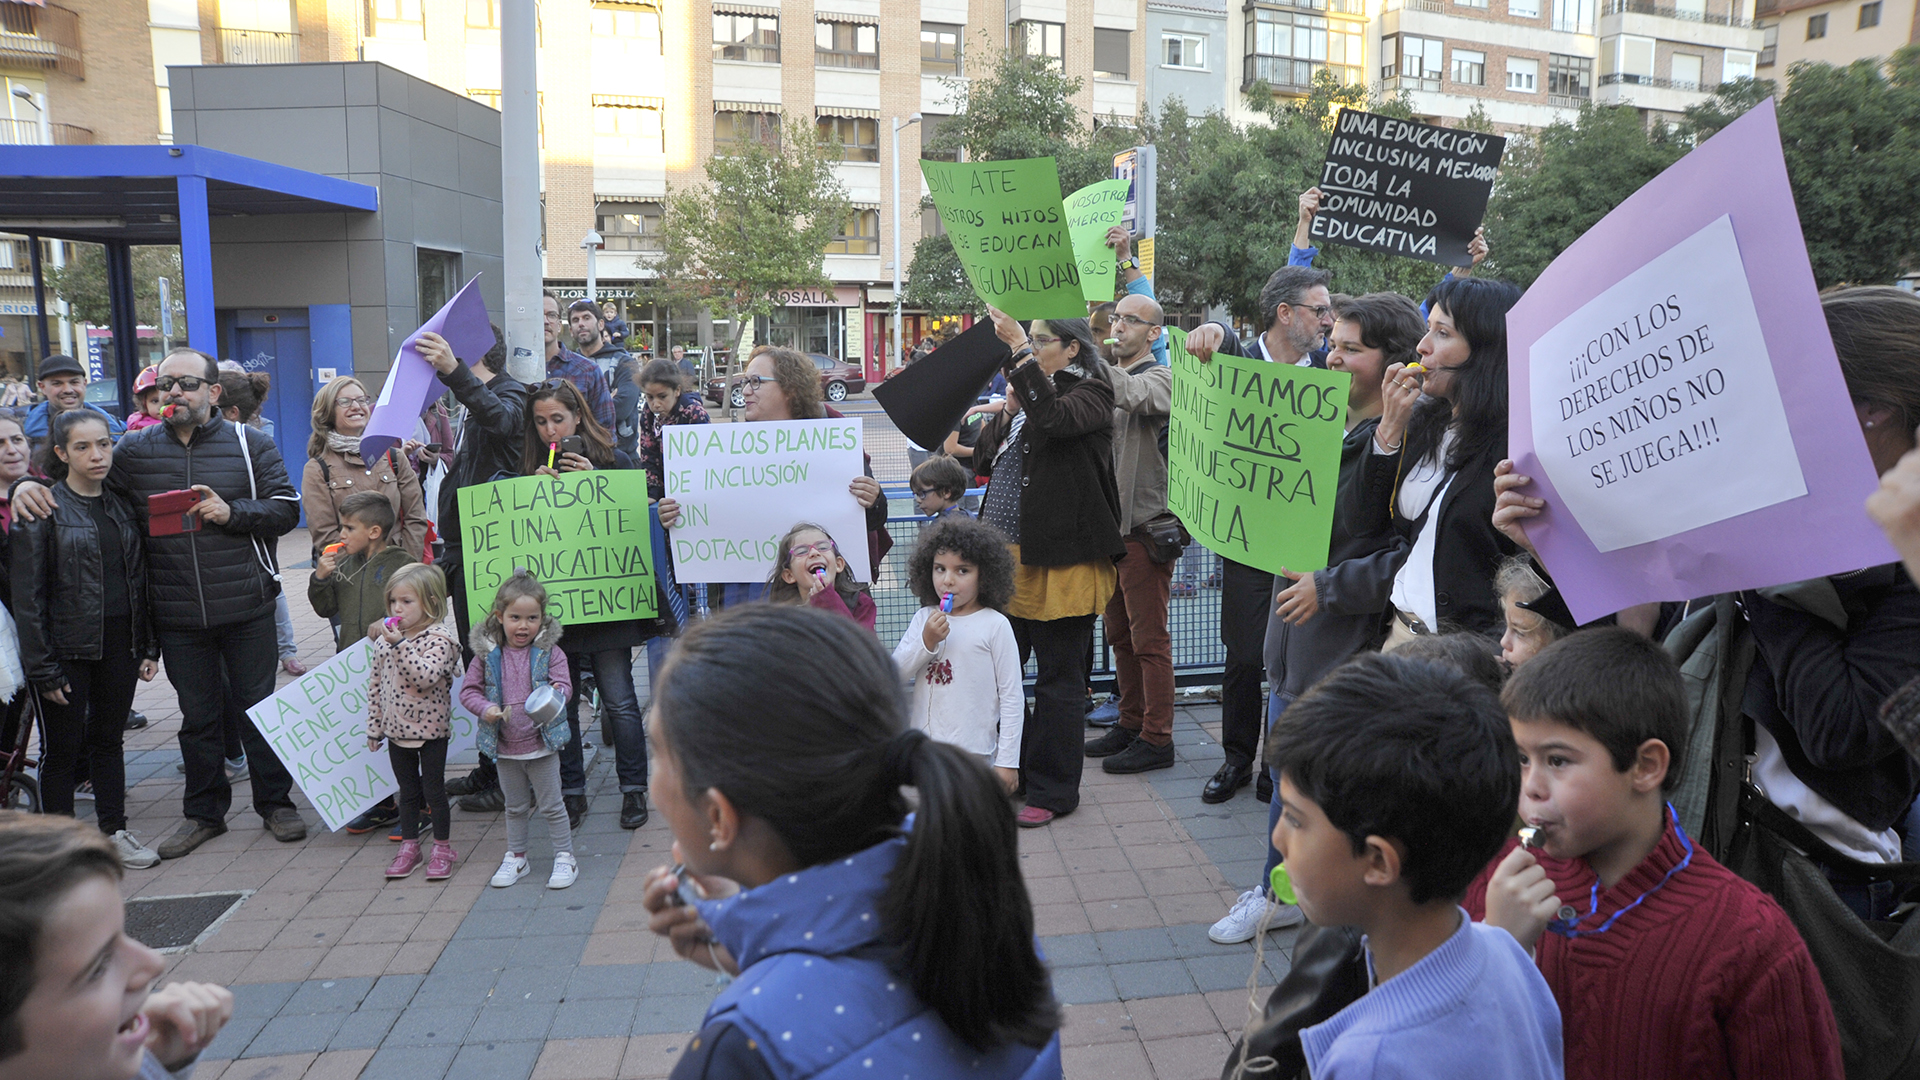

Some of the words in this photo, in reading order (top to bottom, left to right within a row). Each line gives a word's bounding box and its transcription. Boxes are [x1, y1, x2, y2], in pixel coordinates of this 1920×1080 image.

[1340, 112, 1377, 138] UNA
[1380, 119, 1488, 156] EDUCACIÓN
[926, 164, 955, 195] SIN
[970, 169, 1017, 196] ATE
[1322, 161, 1379, 192] TODA
[1385, 174, 1412, 199] LA
[1331, 136, 1429, 174] INCLUSIVA
[1435, 157, 1498, 183] MEJORA
[1318, 191, 1438, 228] COMUNIDAD
[980, 230, 1062, 253] EDUCAN
[1310, 214, 1437, 256] EDUCATIVA
[553, 289, 639, 299] FLORSTERIA
[970, 262, 1081, 296] IGUALDAD
[1633, 294, 1682, 340] LOS
[1172, 334, 1339, 422] NECESITAMOS
[1558, 345, 1674, 422] DERECHOS
[1676, 324, 1715, 363] DE
[1225, 408, 1301, 458] MÁS
[1565, 421, 1606, 459] LOS
[1607, 386, 1683, 440] NIÑOS
[1684, 368, 1726, 406] NO
[668, 430, 699, 460] NO
[703, 430, 725, 457] A
[730, 429, 769, 455] LOS
[774, 426, 857, 453] PLANES
[1590, 459, 1618, 489] SE
[1618, 416, 1721, 479] JUEGA!!!
[669, 469, 692, 495] DE
[704, 459, 809, 491] INCLUSIÓN
[1189, 433, 1317, 507] NUESTRA
[470, 484, 505, 518] LA
[512, 475, 617, 512] LABOR
[1168, 460, 1250, 553] ESCUELA
[470, 520, 500, 554] DE
[511, 513, 563, 547] UNA
[576, 508, 637, 538] ATE
[676, 534, 780, 564] DOTACIÓ
[472, 557, 502, 591] ES
[511, 545, 649, 579] EDUCATIVA
[549, 582, 659, 620] STENCIAL
[254, 697, 301, 734] LA
[299, 643, 374, 706] EDUCA
[272, 702, 342, 761] TIENE
[315, 764, 389, 826] PARA
